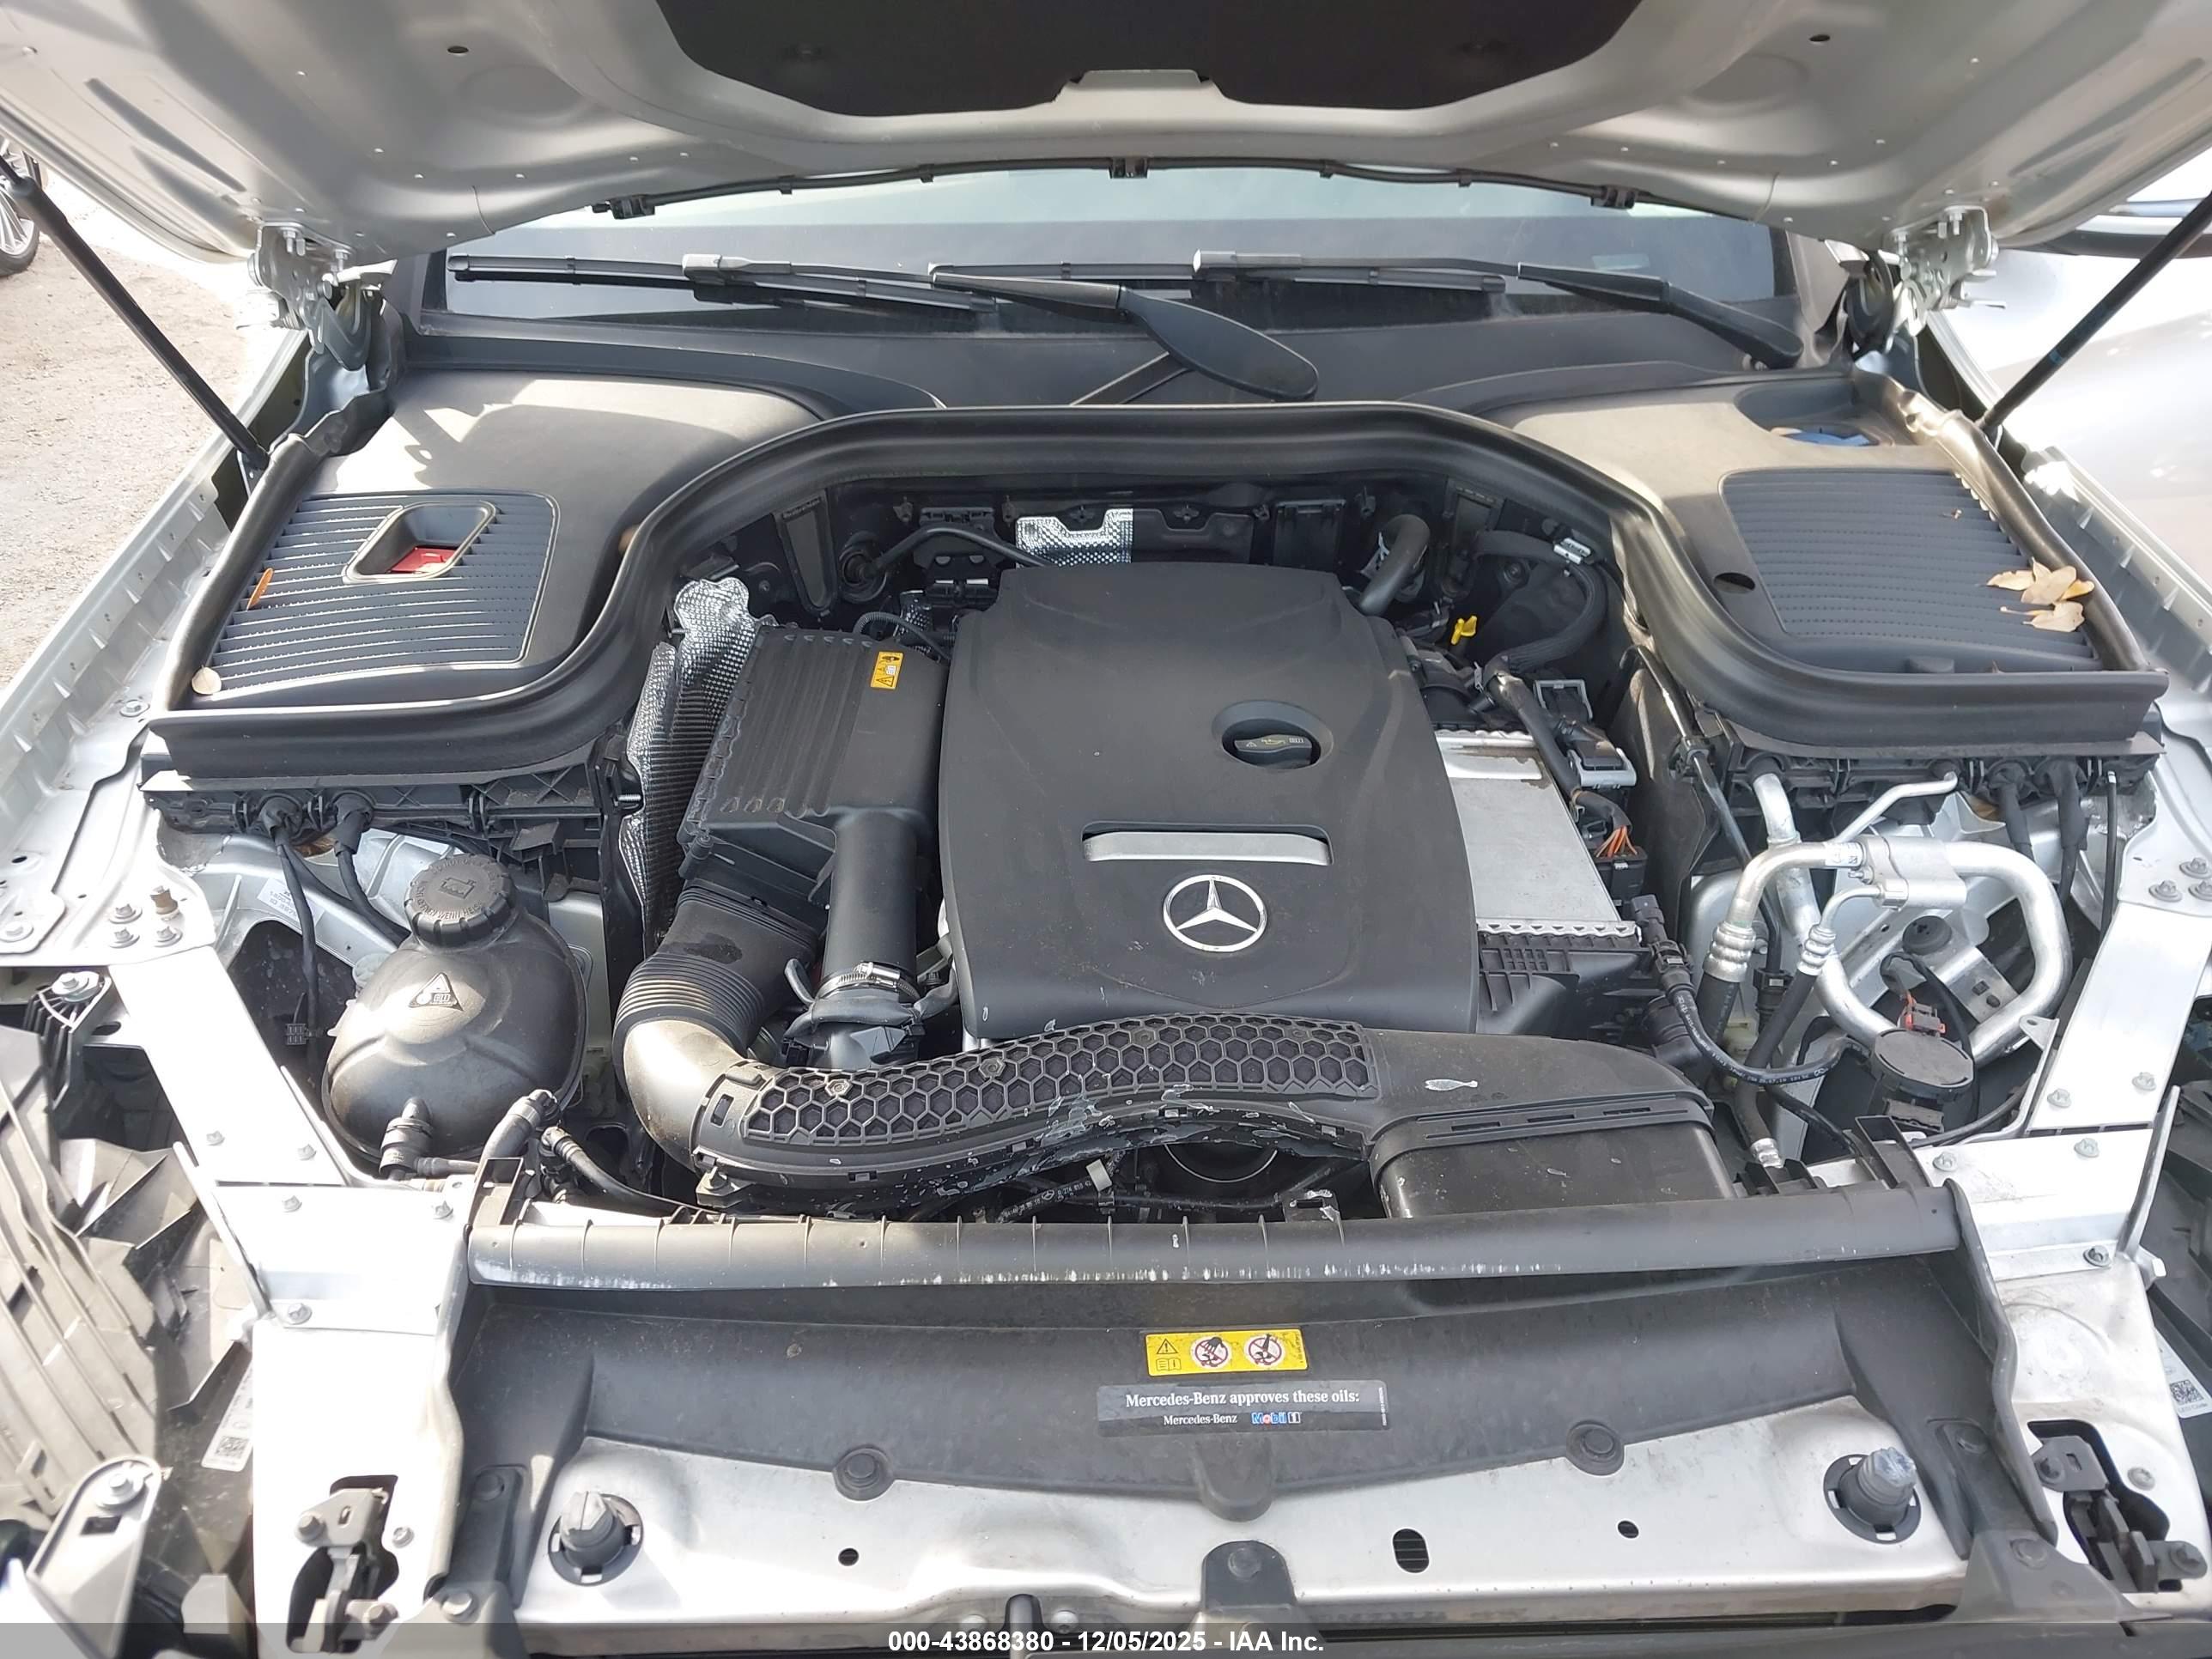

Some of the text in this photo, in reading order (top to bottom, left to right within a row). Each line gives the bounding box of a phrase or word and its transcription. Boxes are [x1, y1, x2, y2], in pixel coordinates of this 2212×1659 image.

[1126, 1389, 1359, 1407] Mercedes-Benz approves these oils:
[1164, 1413, 1237, 1425] Mercedes-Benz
[1251, 1412, 1287, 1425] Mobil
